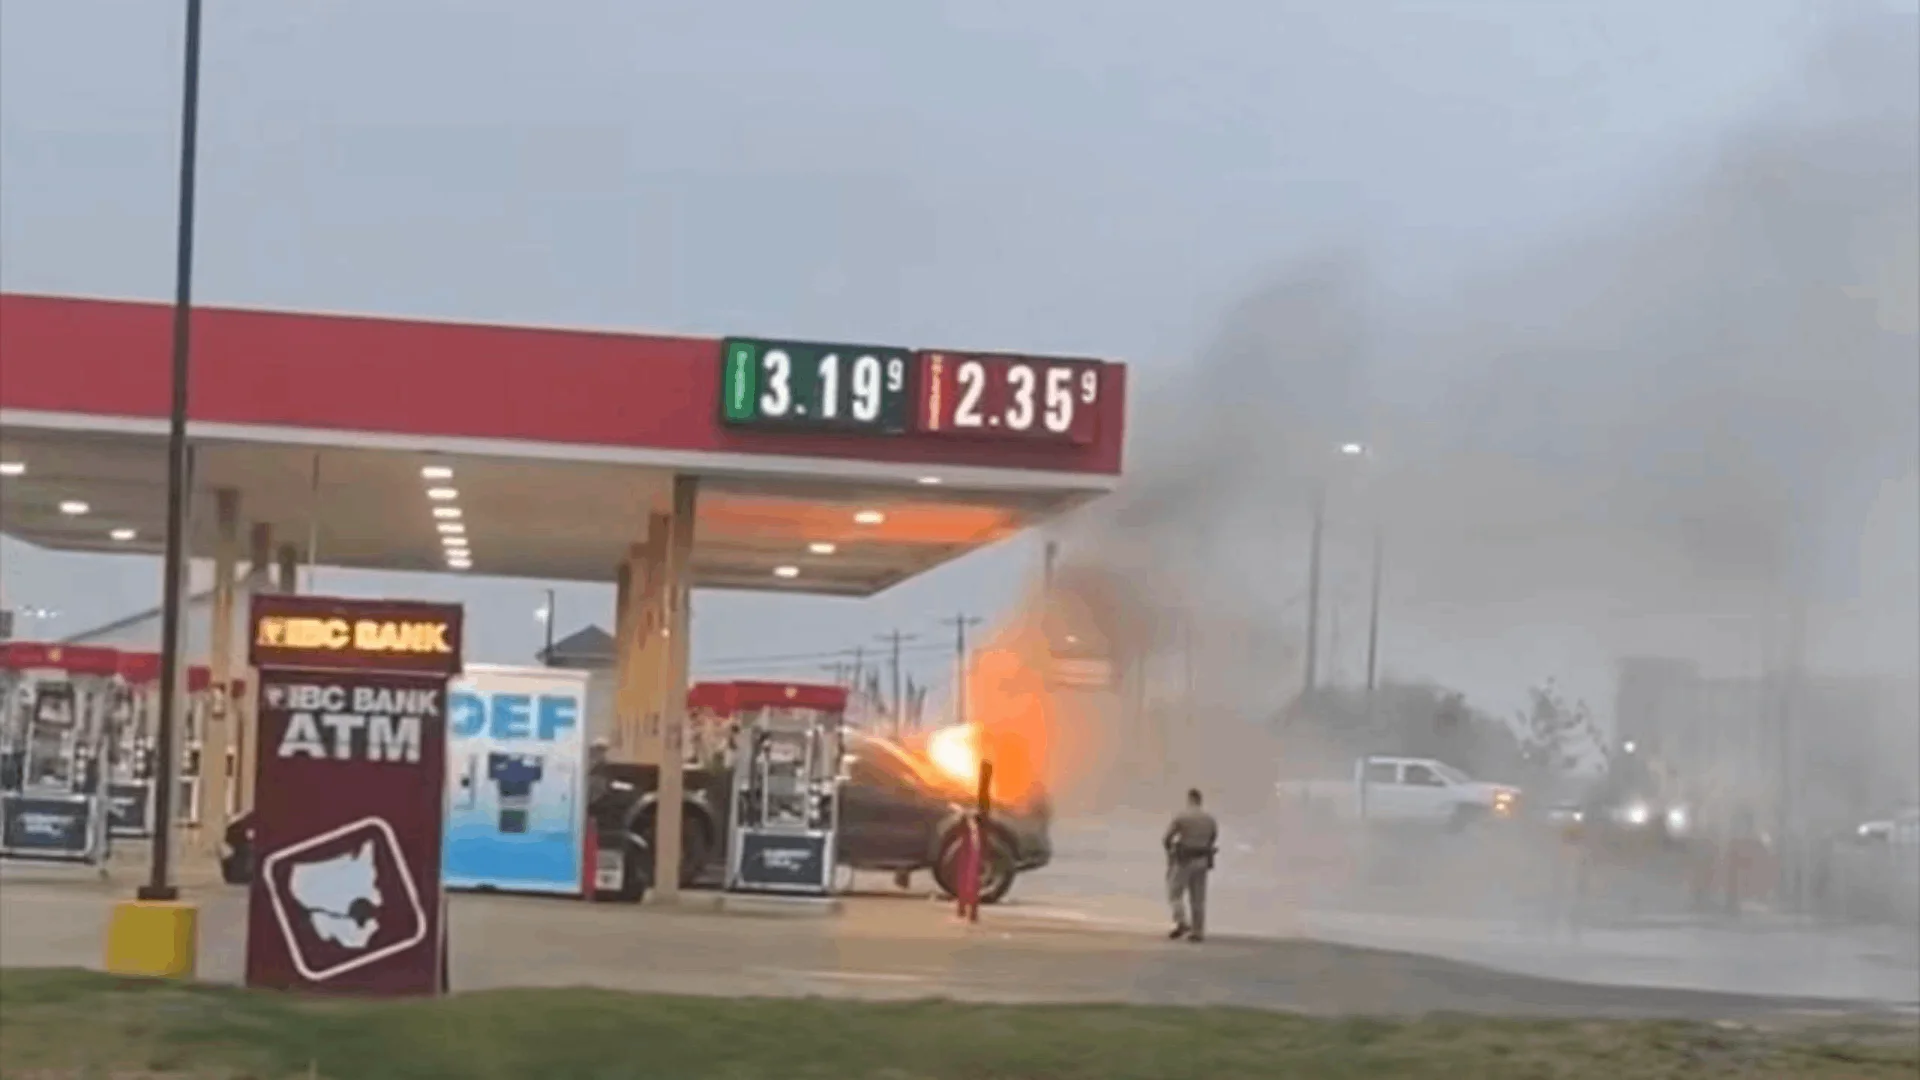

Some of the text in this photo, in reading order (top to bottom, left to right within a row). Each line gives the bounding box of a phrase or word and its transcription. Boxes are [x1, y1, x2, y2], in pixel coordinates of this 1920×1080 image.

[285, 617, 452, 653] IBC BANK
[288, 685, 438, 716] IBC BANK
[276, 713, 422, 763] ATM
